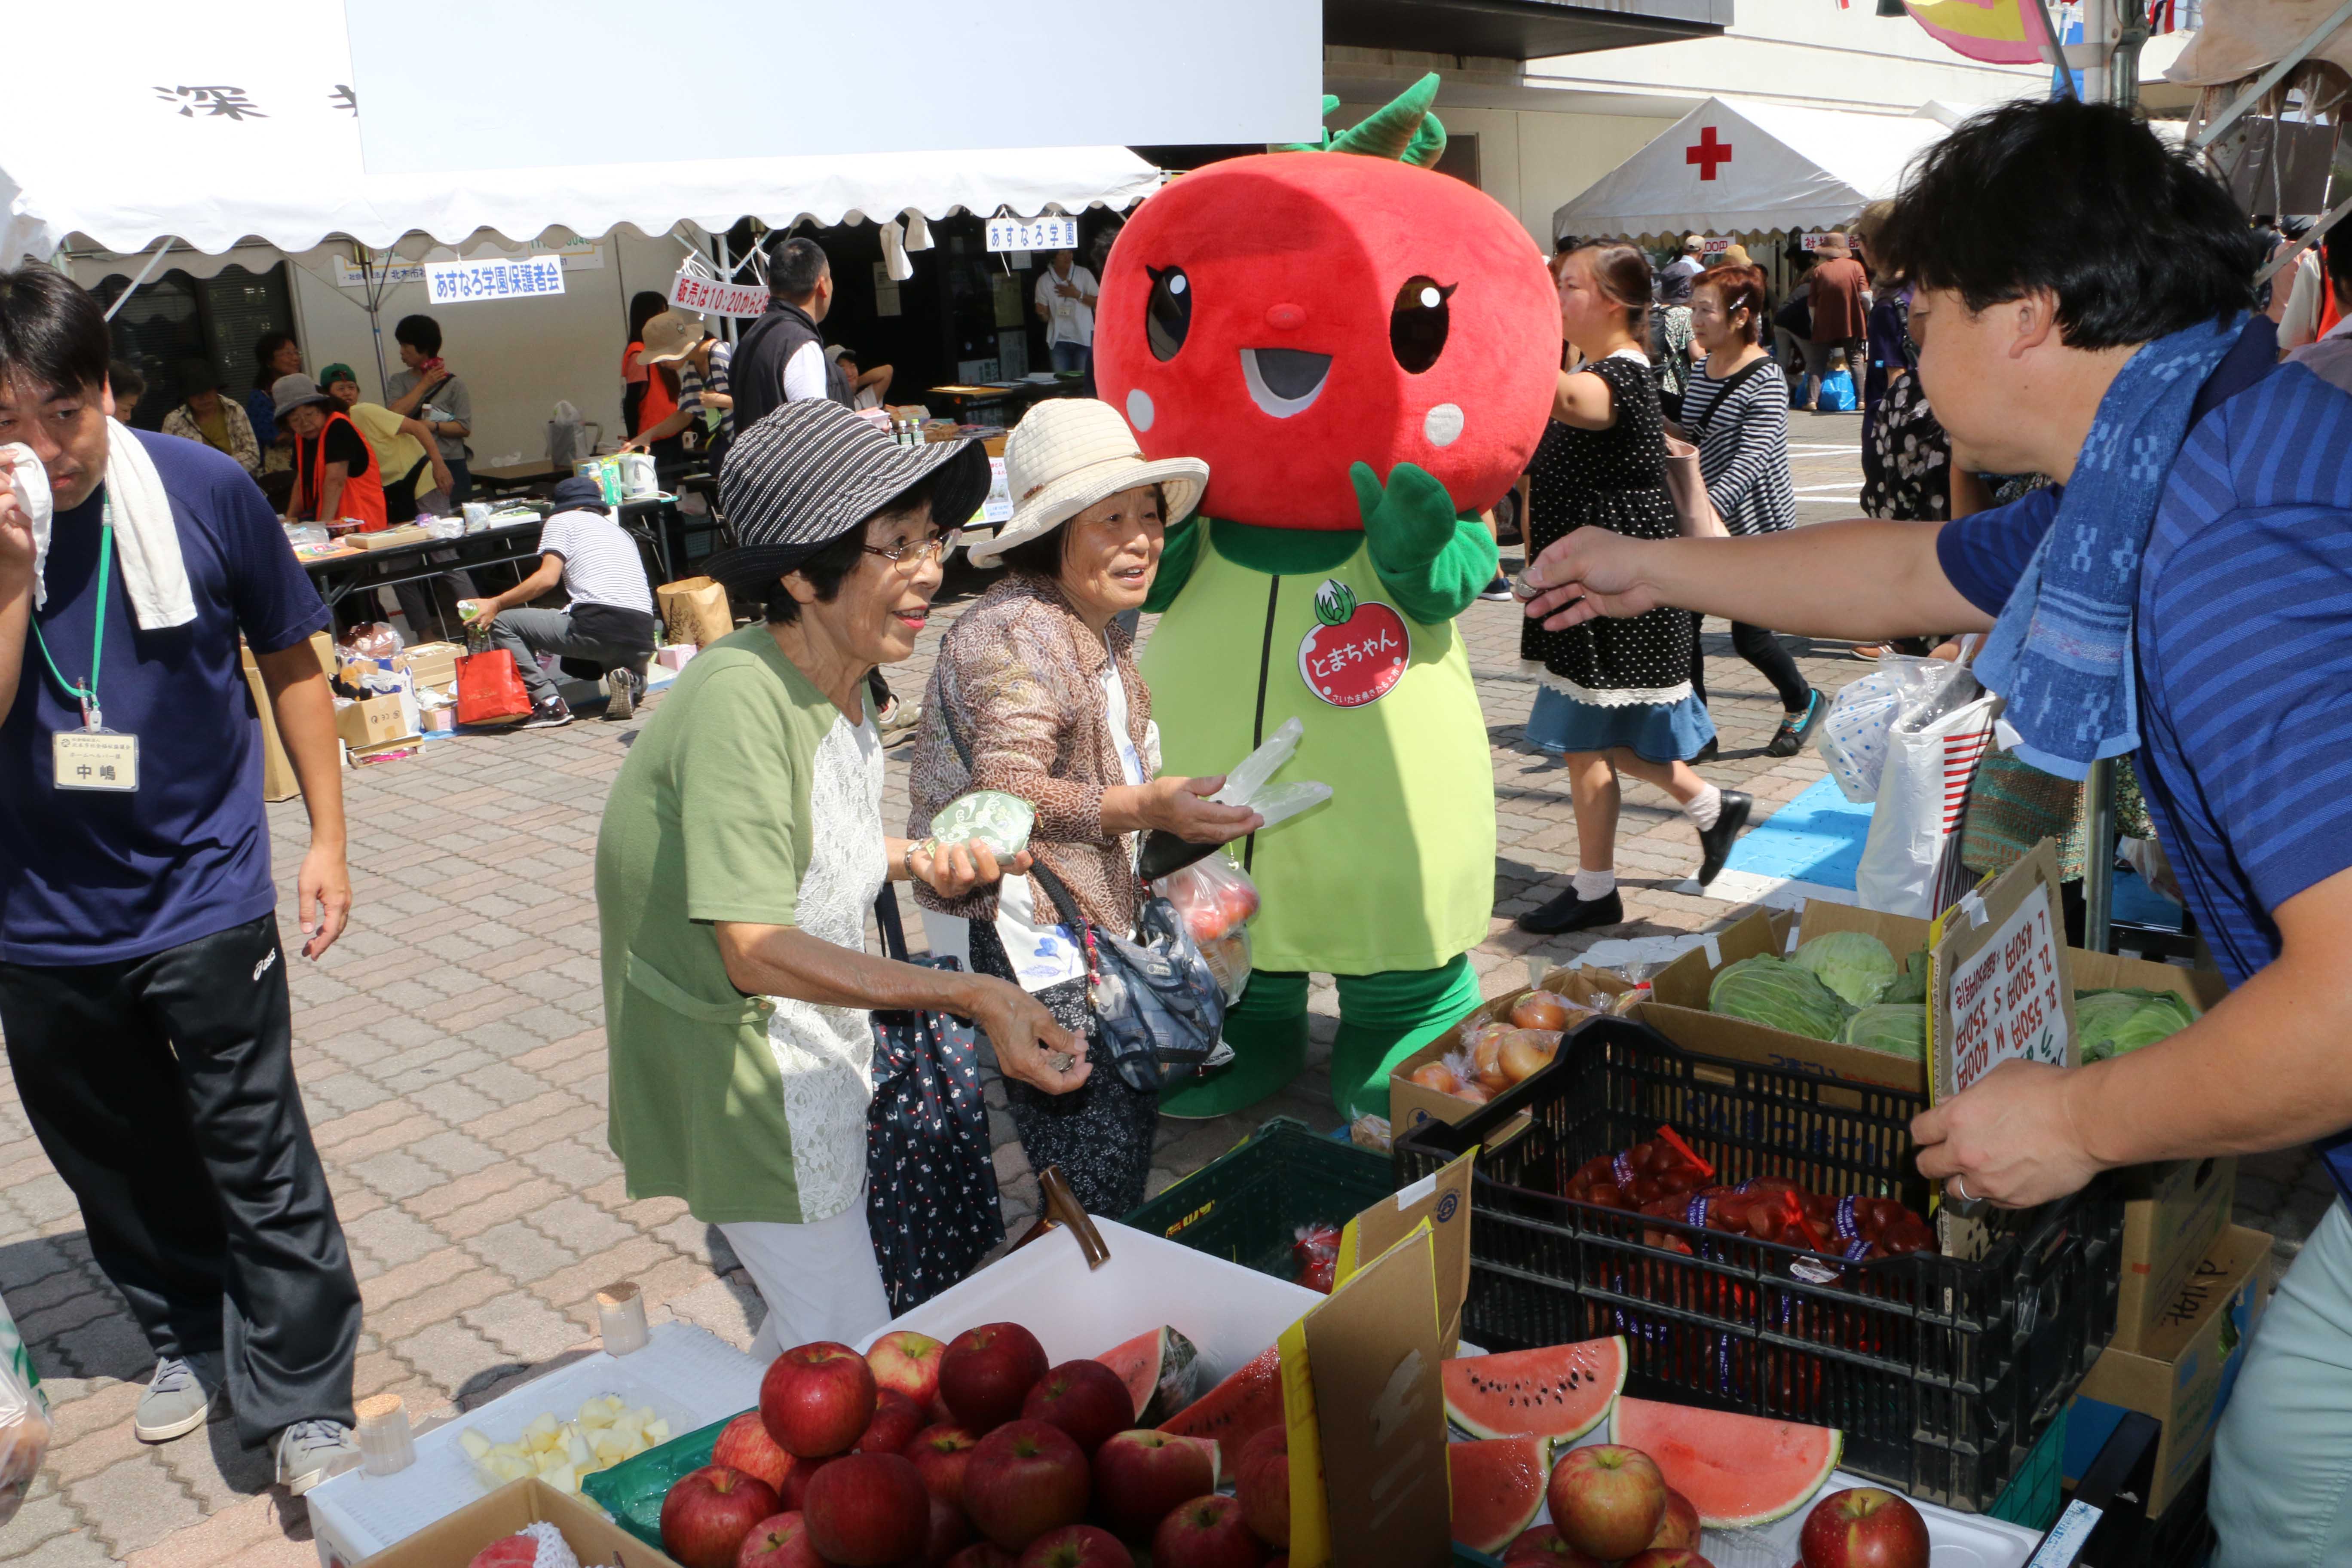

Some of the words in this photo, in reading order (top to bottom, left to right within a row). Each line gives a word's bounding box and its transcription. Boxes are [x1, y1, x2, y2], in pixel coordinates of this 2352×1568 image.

[991, 221, 1074, 248] あすなろ学園
[434, 262, 560, 298] あすなろ学園保護者会
[1311, 628, 1398, 677] とまちゃん
[1332, 667, 1400, 704] さいたま県きたもと市
[2005, 920, 2032, 973] 450円
[2038, 943, 2052, 976] 2L
[2008, 958, 2036, 1011] 500円
[2045, 980, 2057, 1012] 3L
[1956, 997, 1988, 1056] 350円
[2011, 995, 2043, 1051] 550円
[1957, 1036, 1988, 1091] 400円
